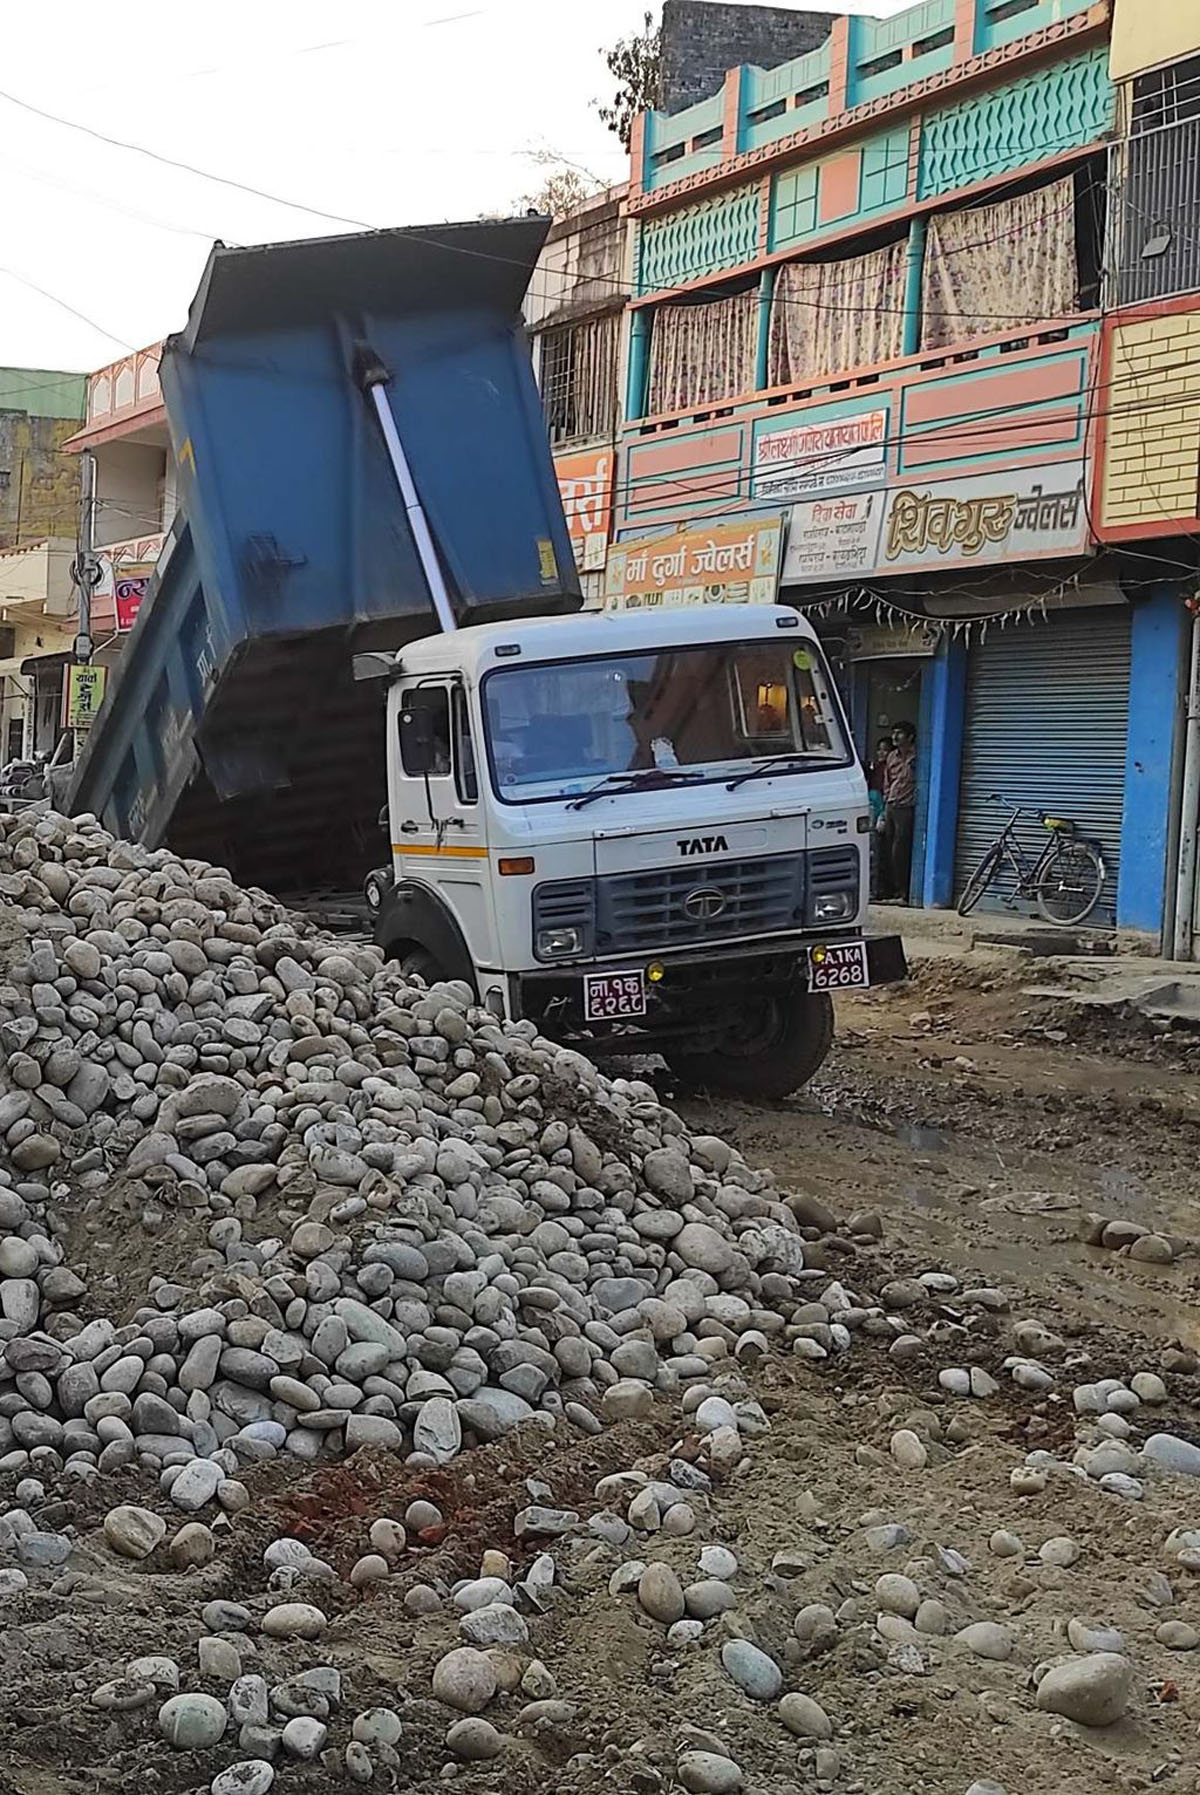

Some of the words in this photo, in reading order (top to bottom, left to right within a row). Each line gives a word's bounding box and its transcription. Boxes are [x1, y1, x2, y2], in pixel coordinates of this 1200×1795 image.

[1014, 478, 1086, 531] ज्वेलर्स
[652, 545, 687, 586] दुर्गा
[690, 536, 757, 575] ज्वेलर्स
[676, 836, 728, 856] TATA
[815, 965, 862, 986] 6268
[591, 994, 642, 1016] ६२६८
